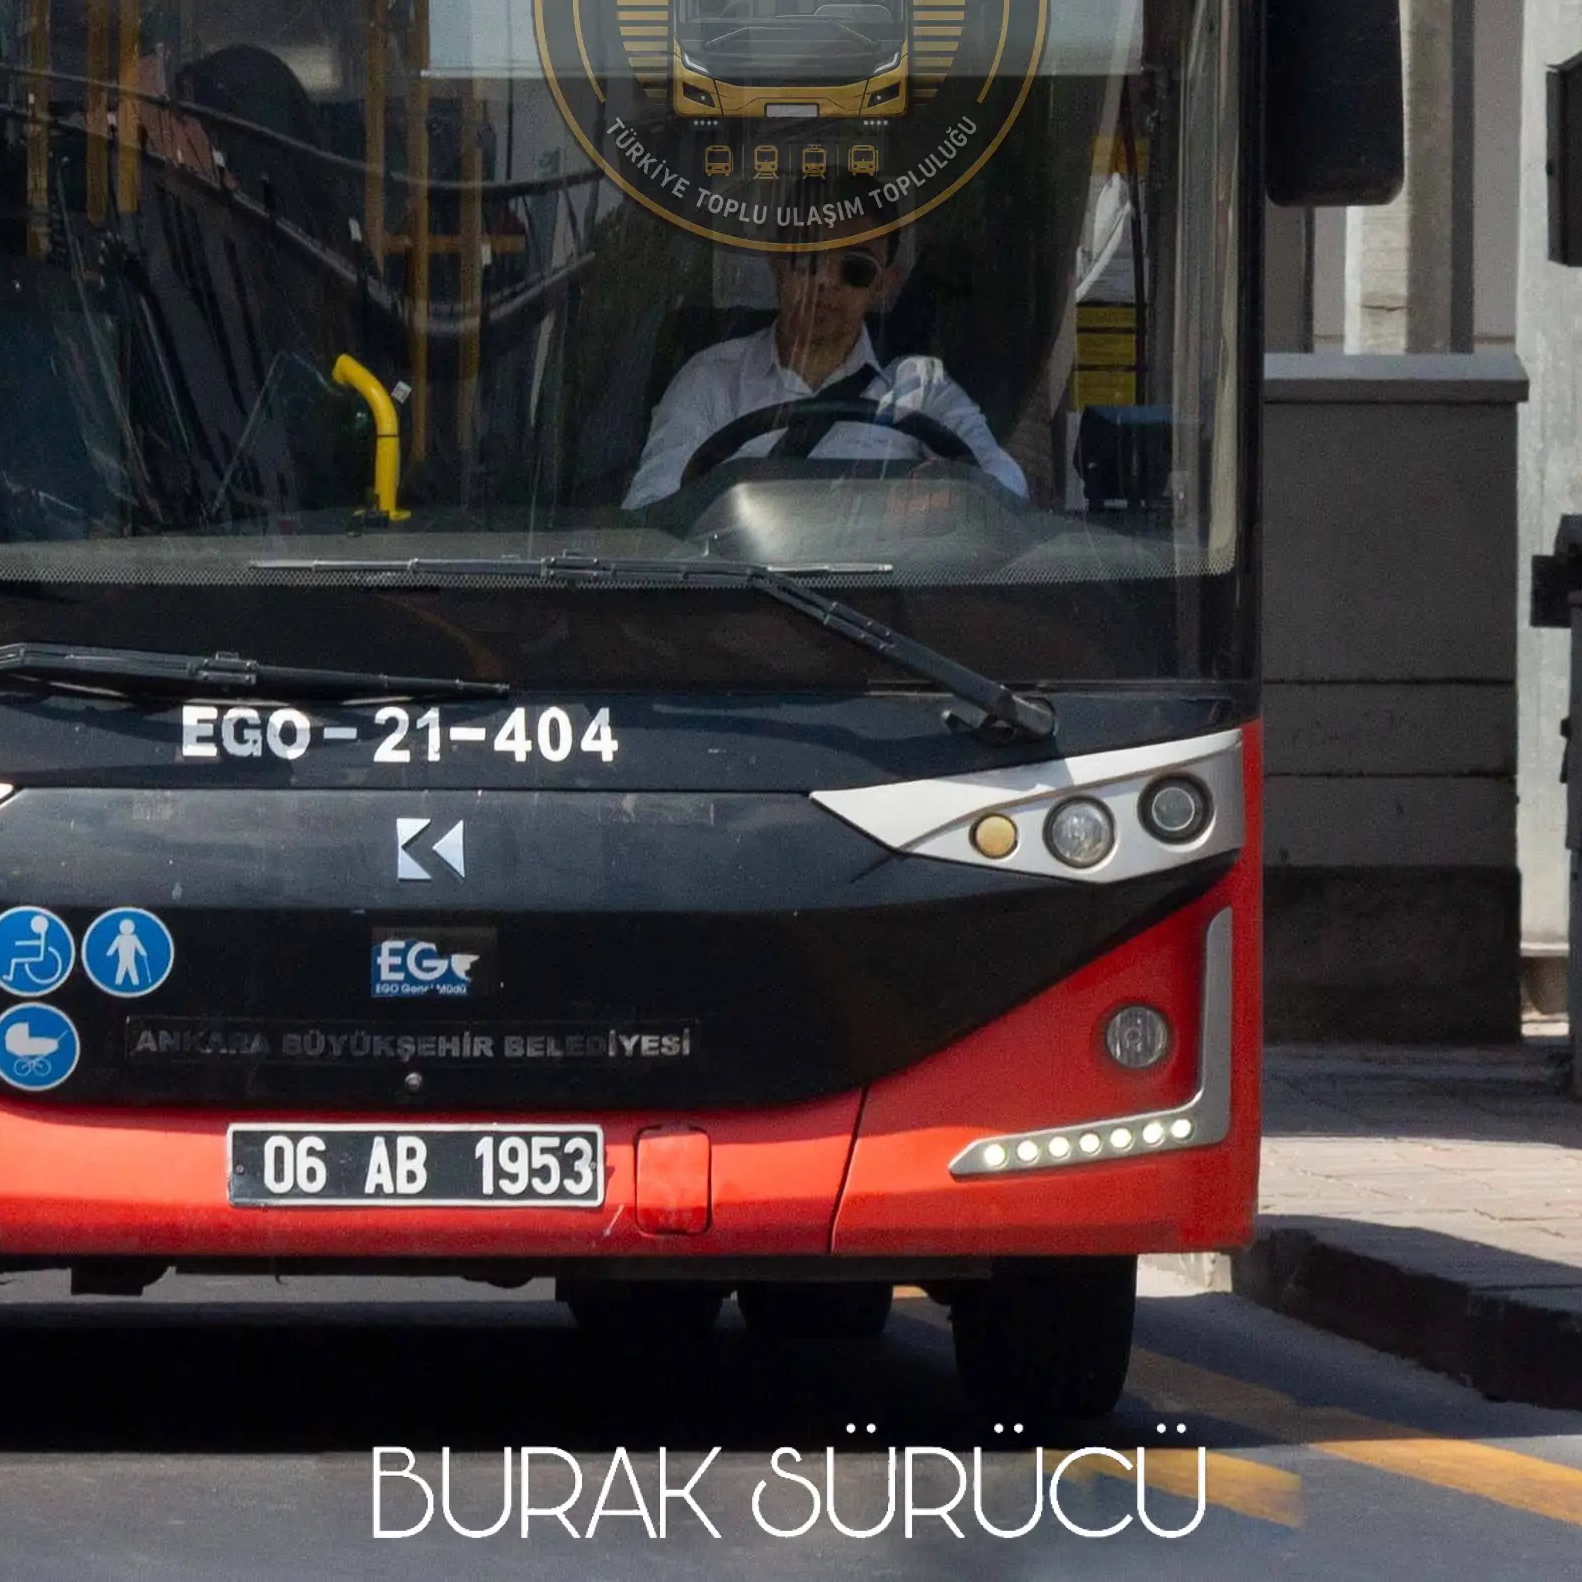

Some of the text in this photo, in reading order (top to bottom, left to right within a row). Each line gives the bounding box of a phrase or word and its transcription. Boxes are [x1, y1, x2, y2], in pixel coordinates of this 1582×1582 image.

[281, 1028, 494, 1063] BÜYÜKŞEHİR
[504, 1027, 691, 1059] BELEDİYESİ
[263, 1134, 594, 1196] 06 AB 1953
